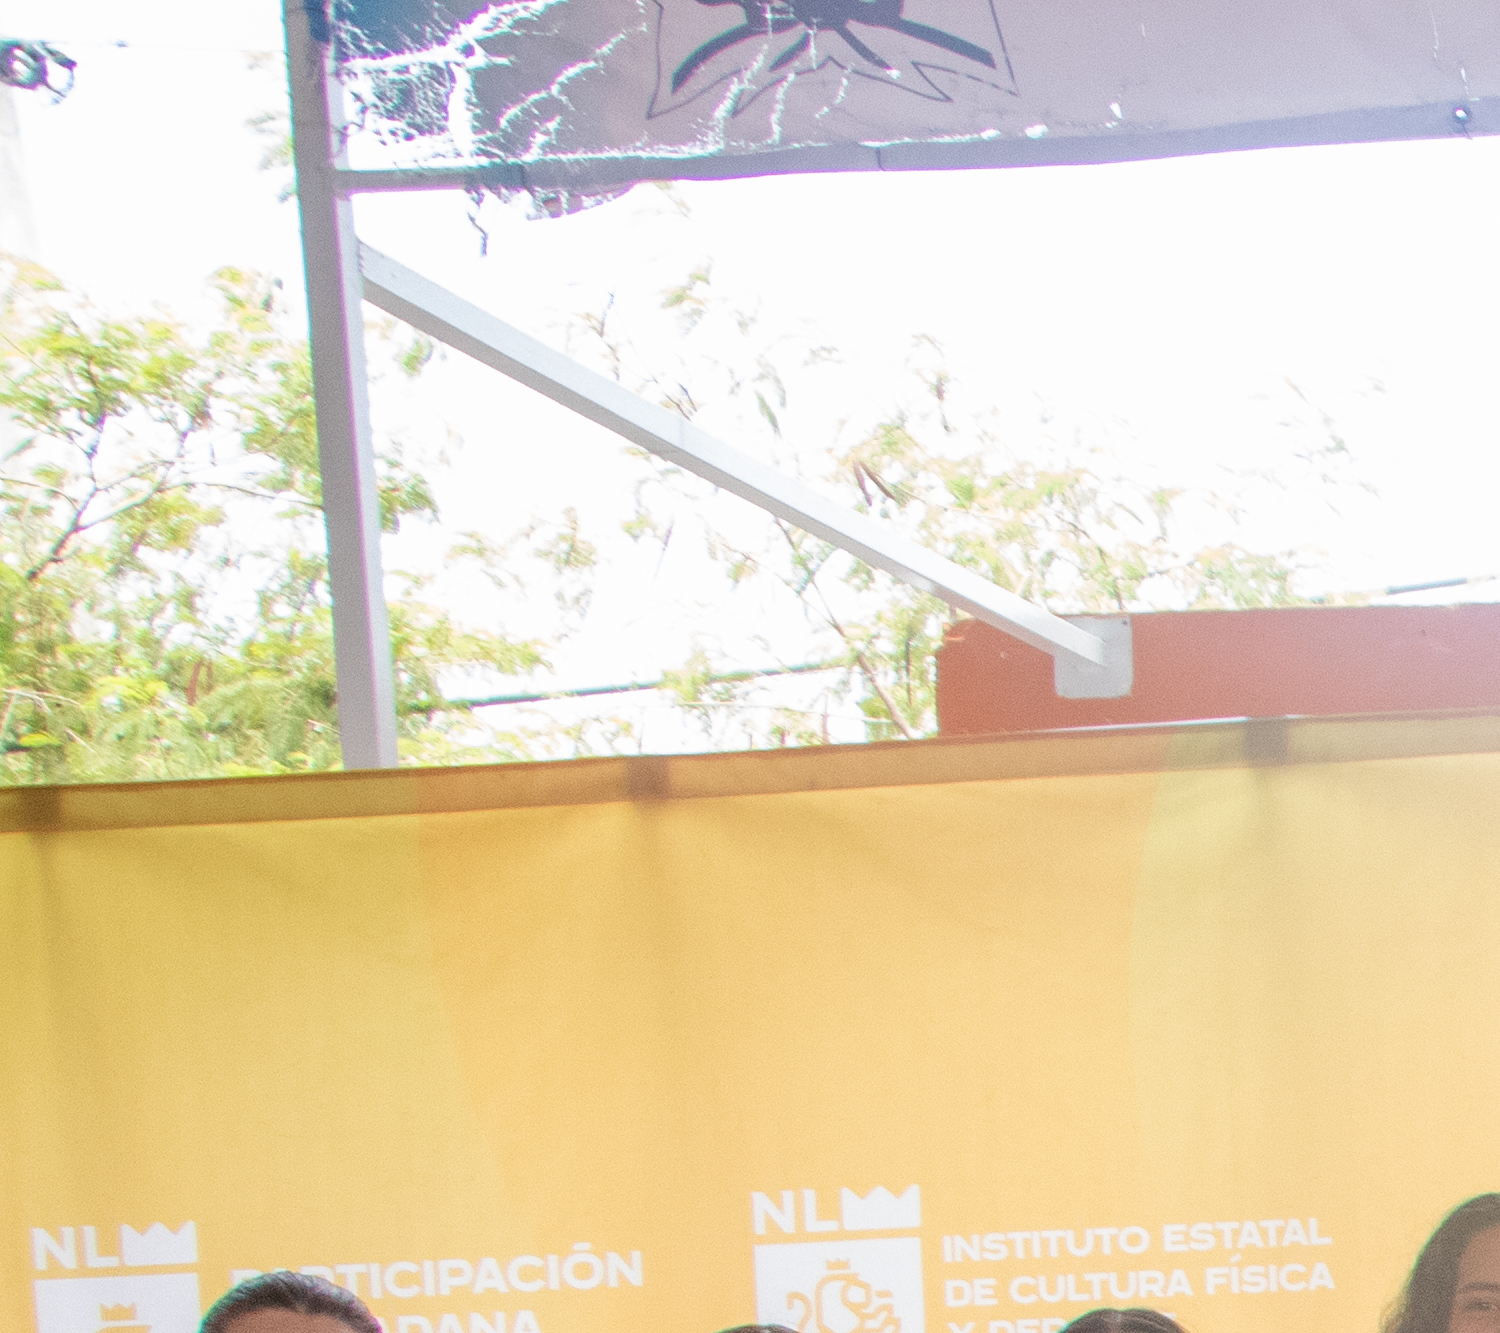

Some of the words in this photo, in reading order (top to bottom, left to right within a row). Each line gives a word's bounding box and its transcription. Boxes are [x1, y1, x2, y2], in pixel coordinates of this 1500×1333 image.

[752, 1188, 839, 1235] NL
[31, 1223, 119, 1271] NL
[942, 1226, 1150, 1264] INSTITUTO
[1163, 1217, 1333, 1253] ESTATAL
[944, 1278, 998, 1308] DE
[1009, 1269, 1194, 1306] CULTURA
[1205, 1253, 1336, 1296] FÍSICA
